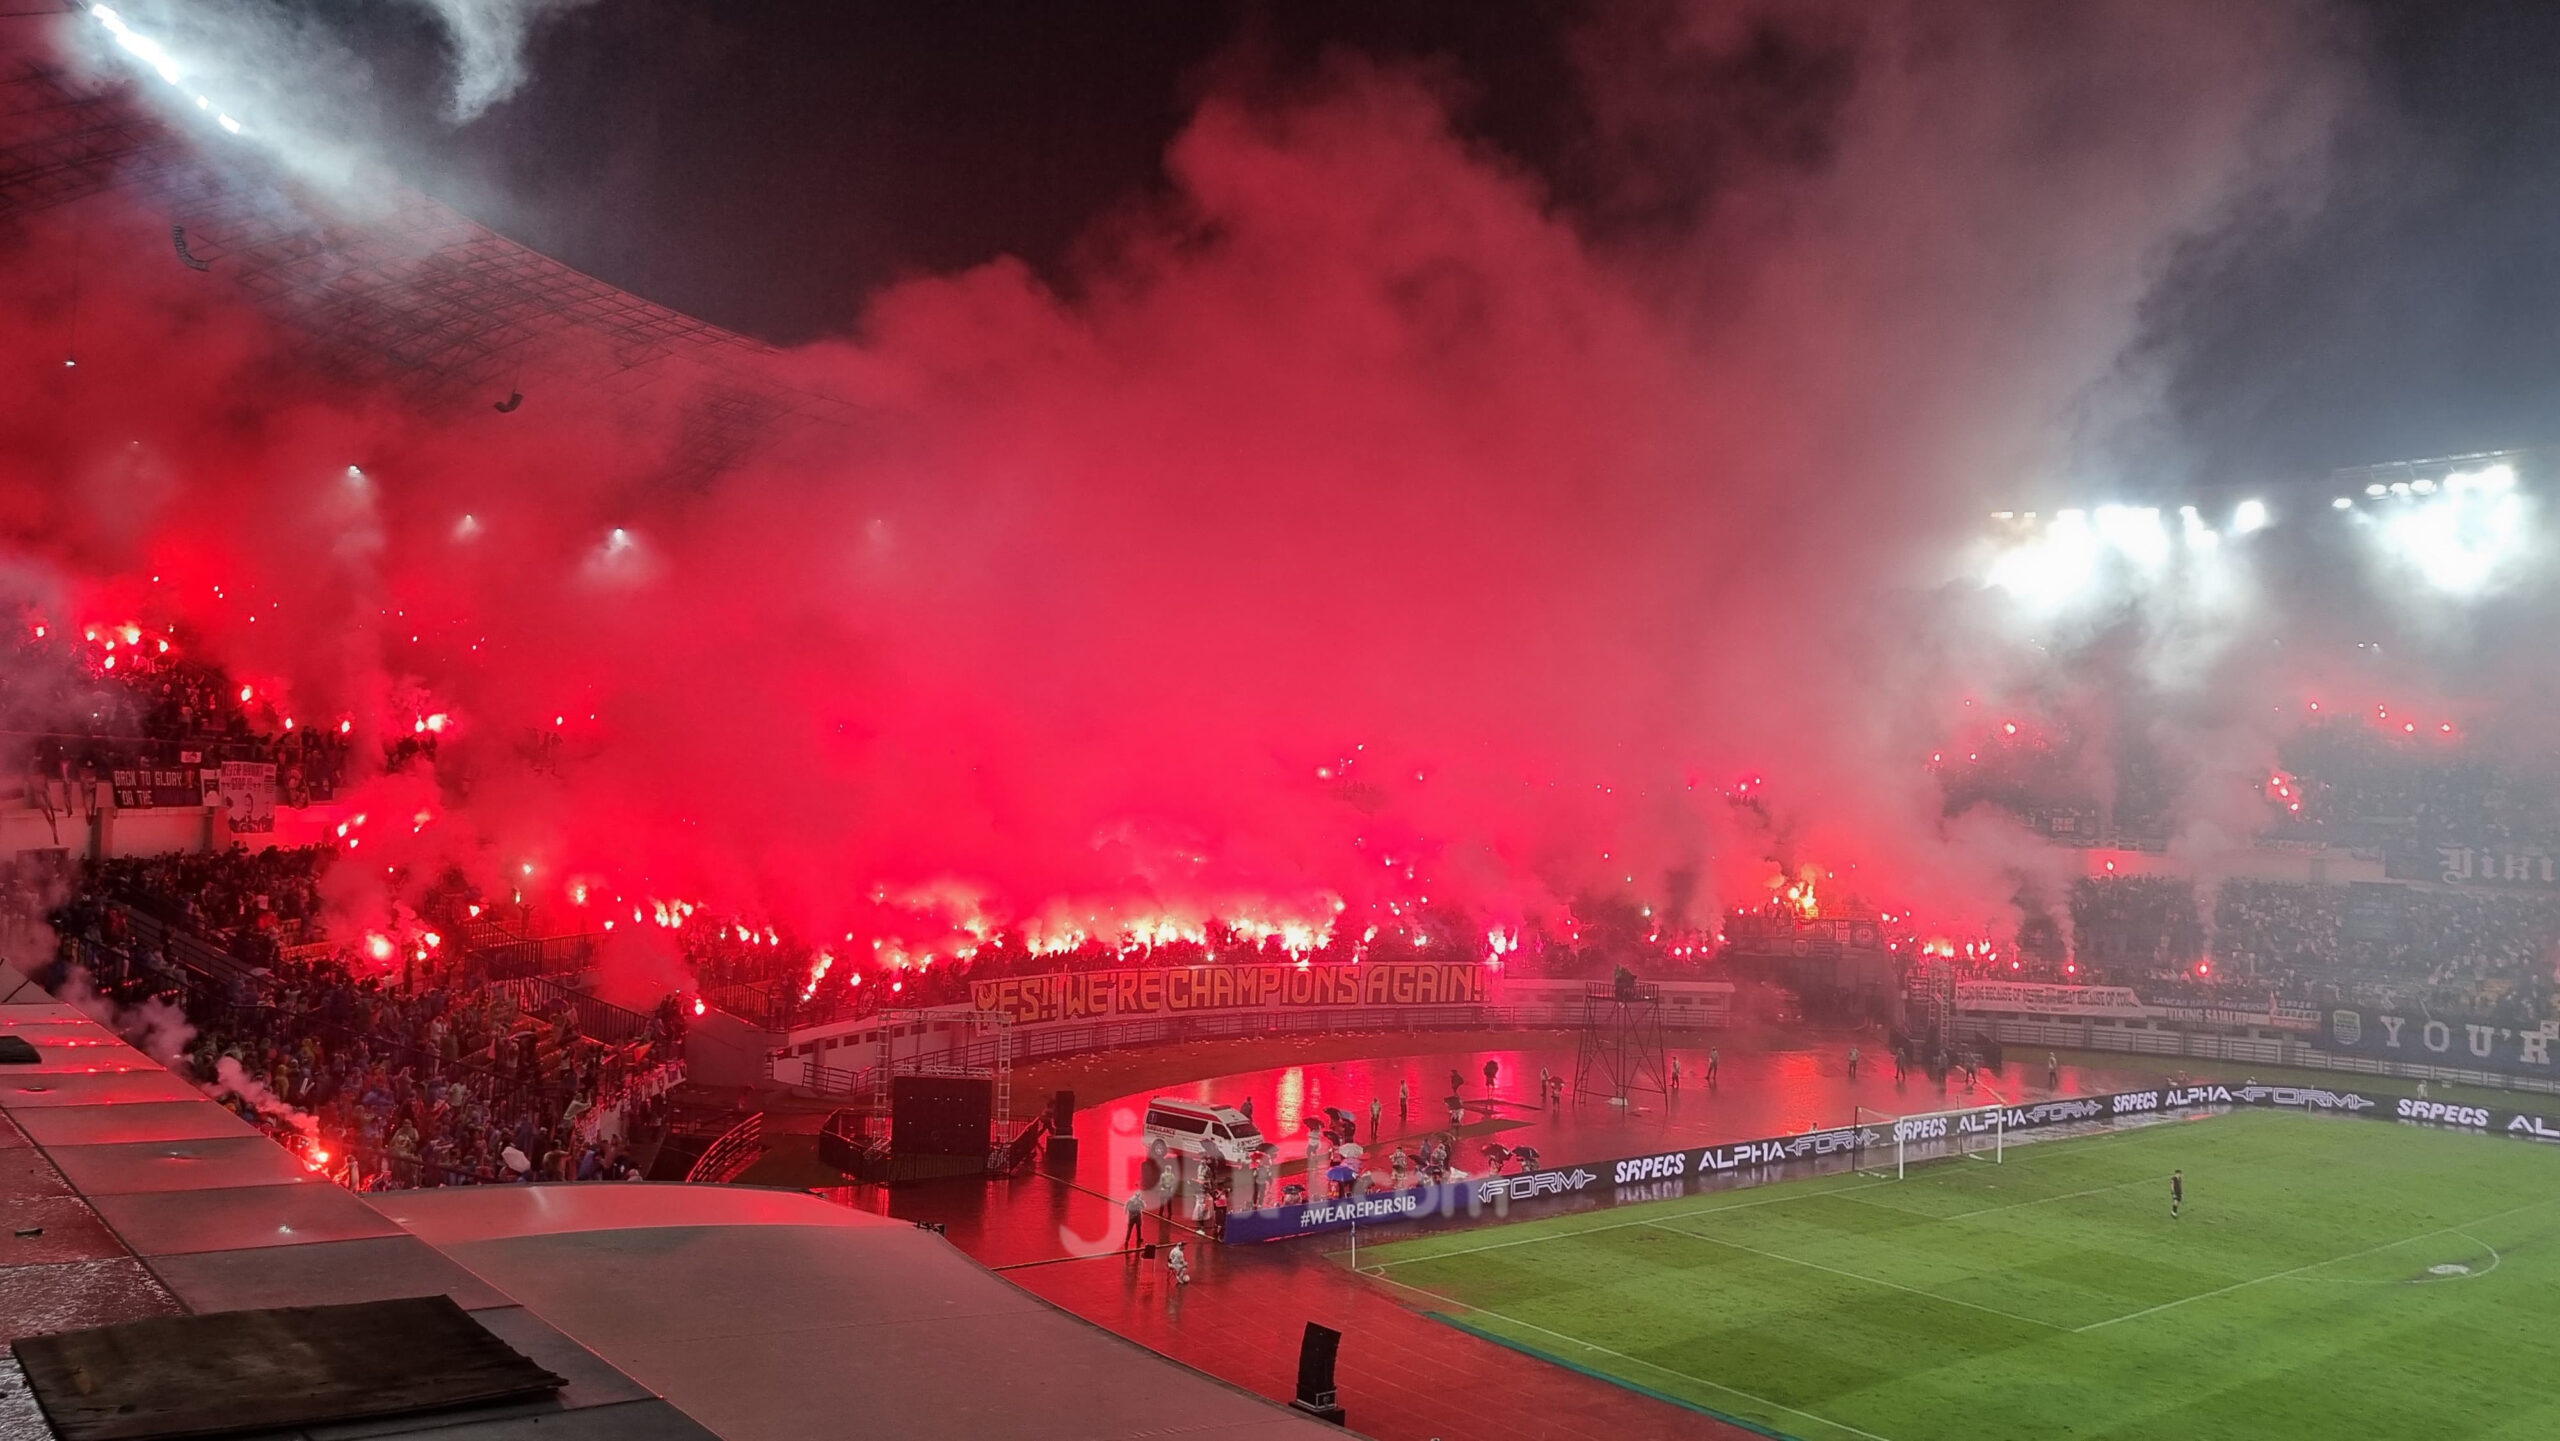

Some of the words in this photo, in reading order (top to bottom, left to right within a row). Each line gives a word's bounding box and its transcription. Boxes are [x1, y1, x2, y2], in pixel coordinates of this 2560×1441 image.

[140, 770, 151, 786] TO
[1066, 972, 1161, 1017] WE'RE
[1168, 966, 1360, 1008] CHAMPIONS
[2165, 1086, 2232, 1106] ALPHA
[1146, 1124, 1176, 1135] AMBULANCE
[1699, 1141, 1786, 1171] ALPHA
[1300, 1196, 1416, 1228] #WEAREPERSIB
